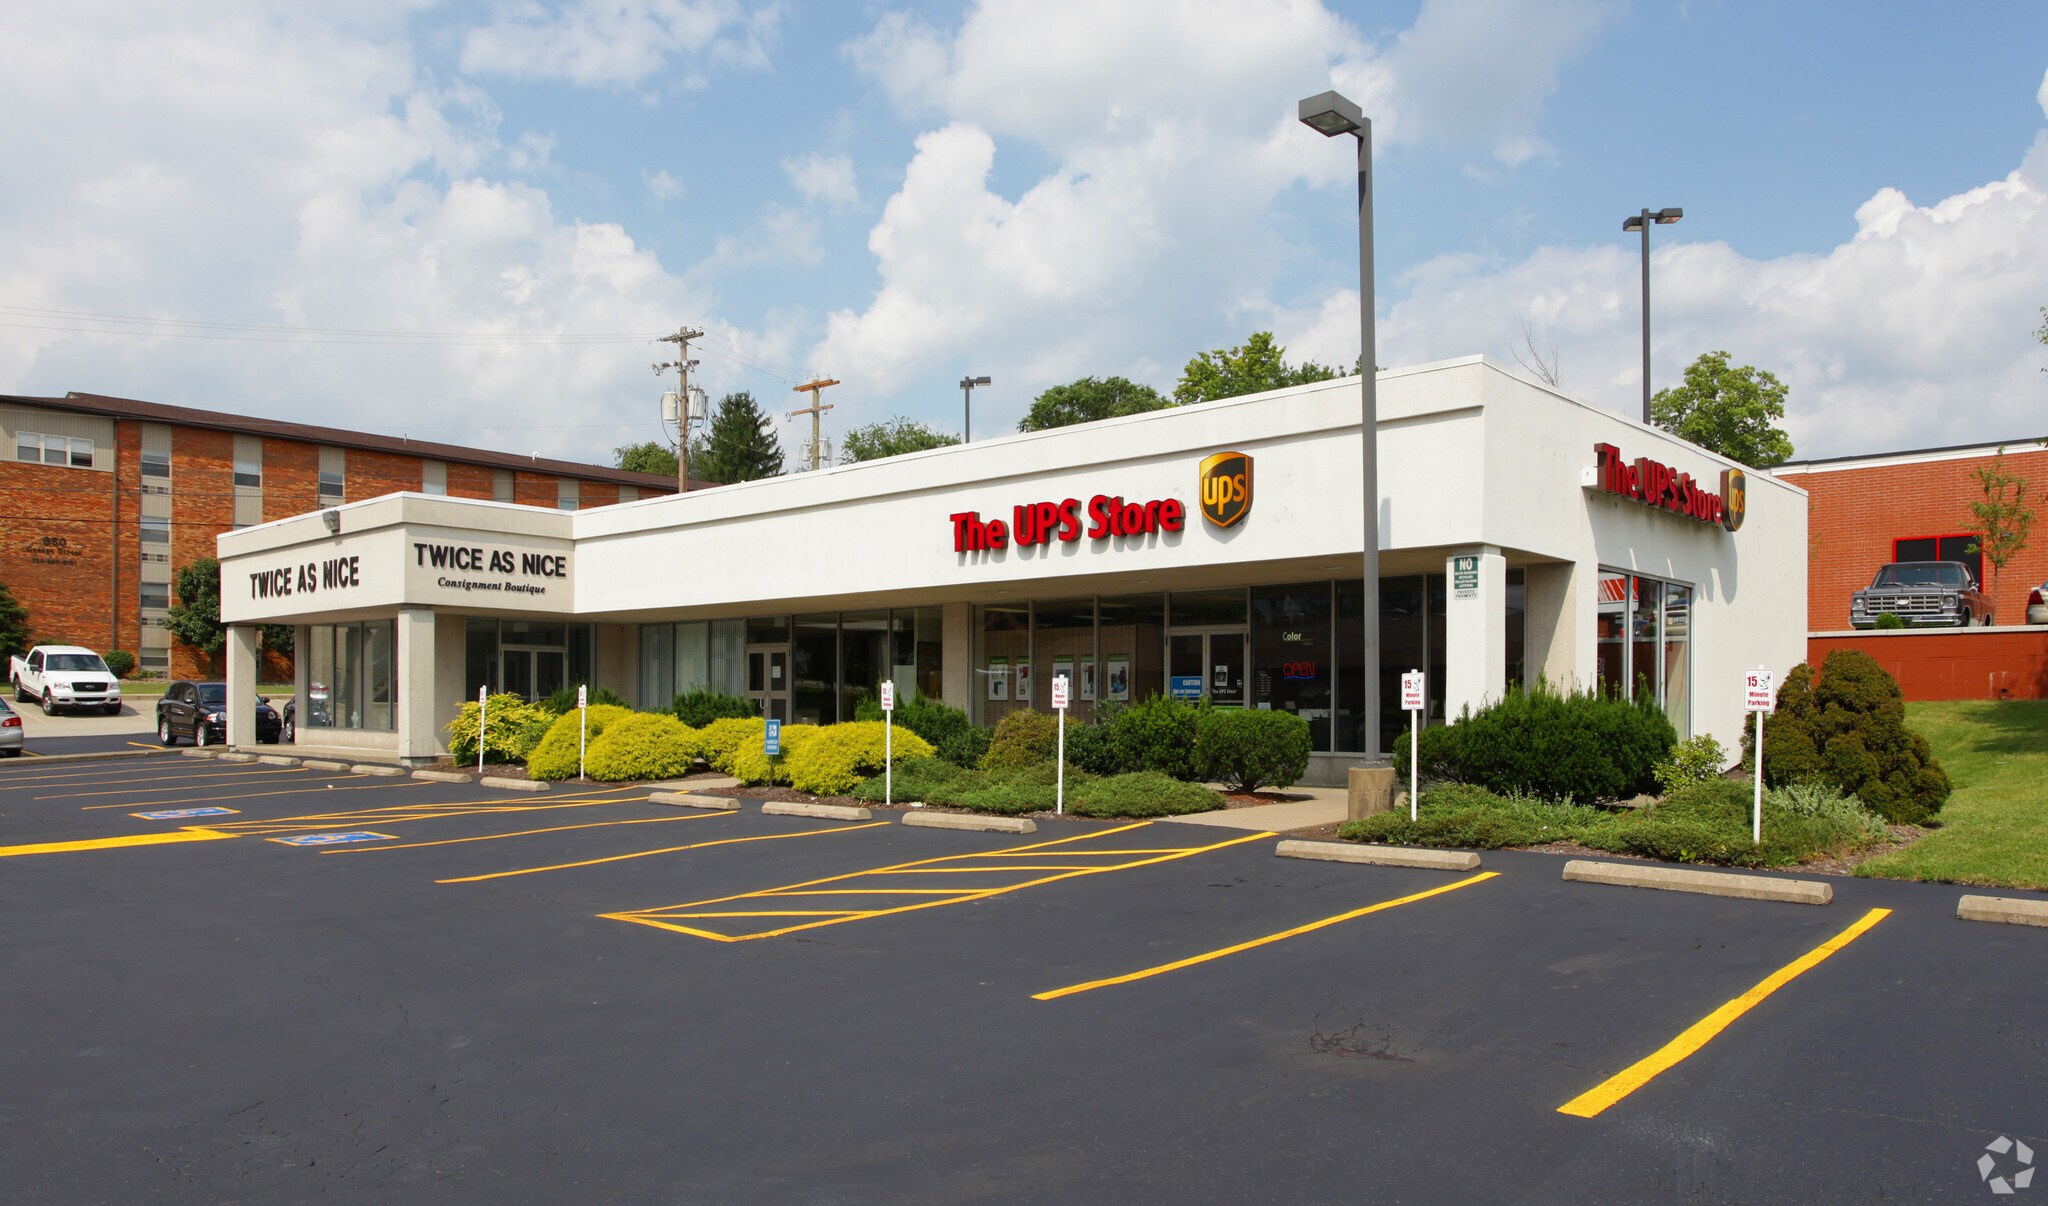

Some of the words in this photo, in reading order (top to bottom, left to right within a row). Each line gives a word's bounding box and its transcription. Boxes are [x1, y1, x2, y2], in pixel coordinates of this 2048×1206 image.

[1204, 473, 1245, 516] ups
[1594, 443, 1639, 499] The
[1639, 457, 1679, 511] UPS
[1681, 472, 1722, 524] Store
[1728, 486, 1744, 521] ups
[950, 511, 1007, 552] The
[1013, 498, 1081, 546] UPS
[1088, 494, 1184, 539] Store
[414, 543, 483, 570] TWICE
[489, 550, 515, 574] AS
[522, 553, 567, 577] NICE
[1459, 558, 1473, 571] NO
[250, 567, 292, 599] TWICE
[297, 563, 317, 593] AS
[323, 556, 359, 588] NICE
[438, 577, 502, 596] Consignment
[504, 582, 546, 596] Boutique
[1282, 631, 1302, 641] Color
[1283, 662, 1316, 677] OPEN
[1747, 676, 1758, 687] 15
[1404, 680, 1412, 689] 15
